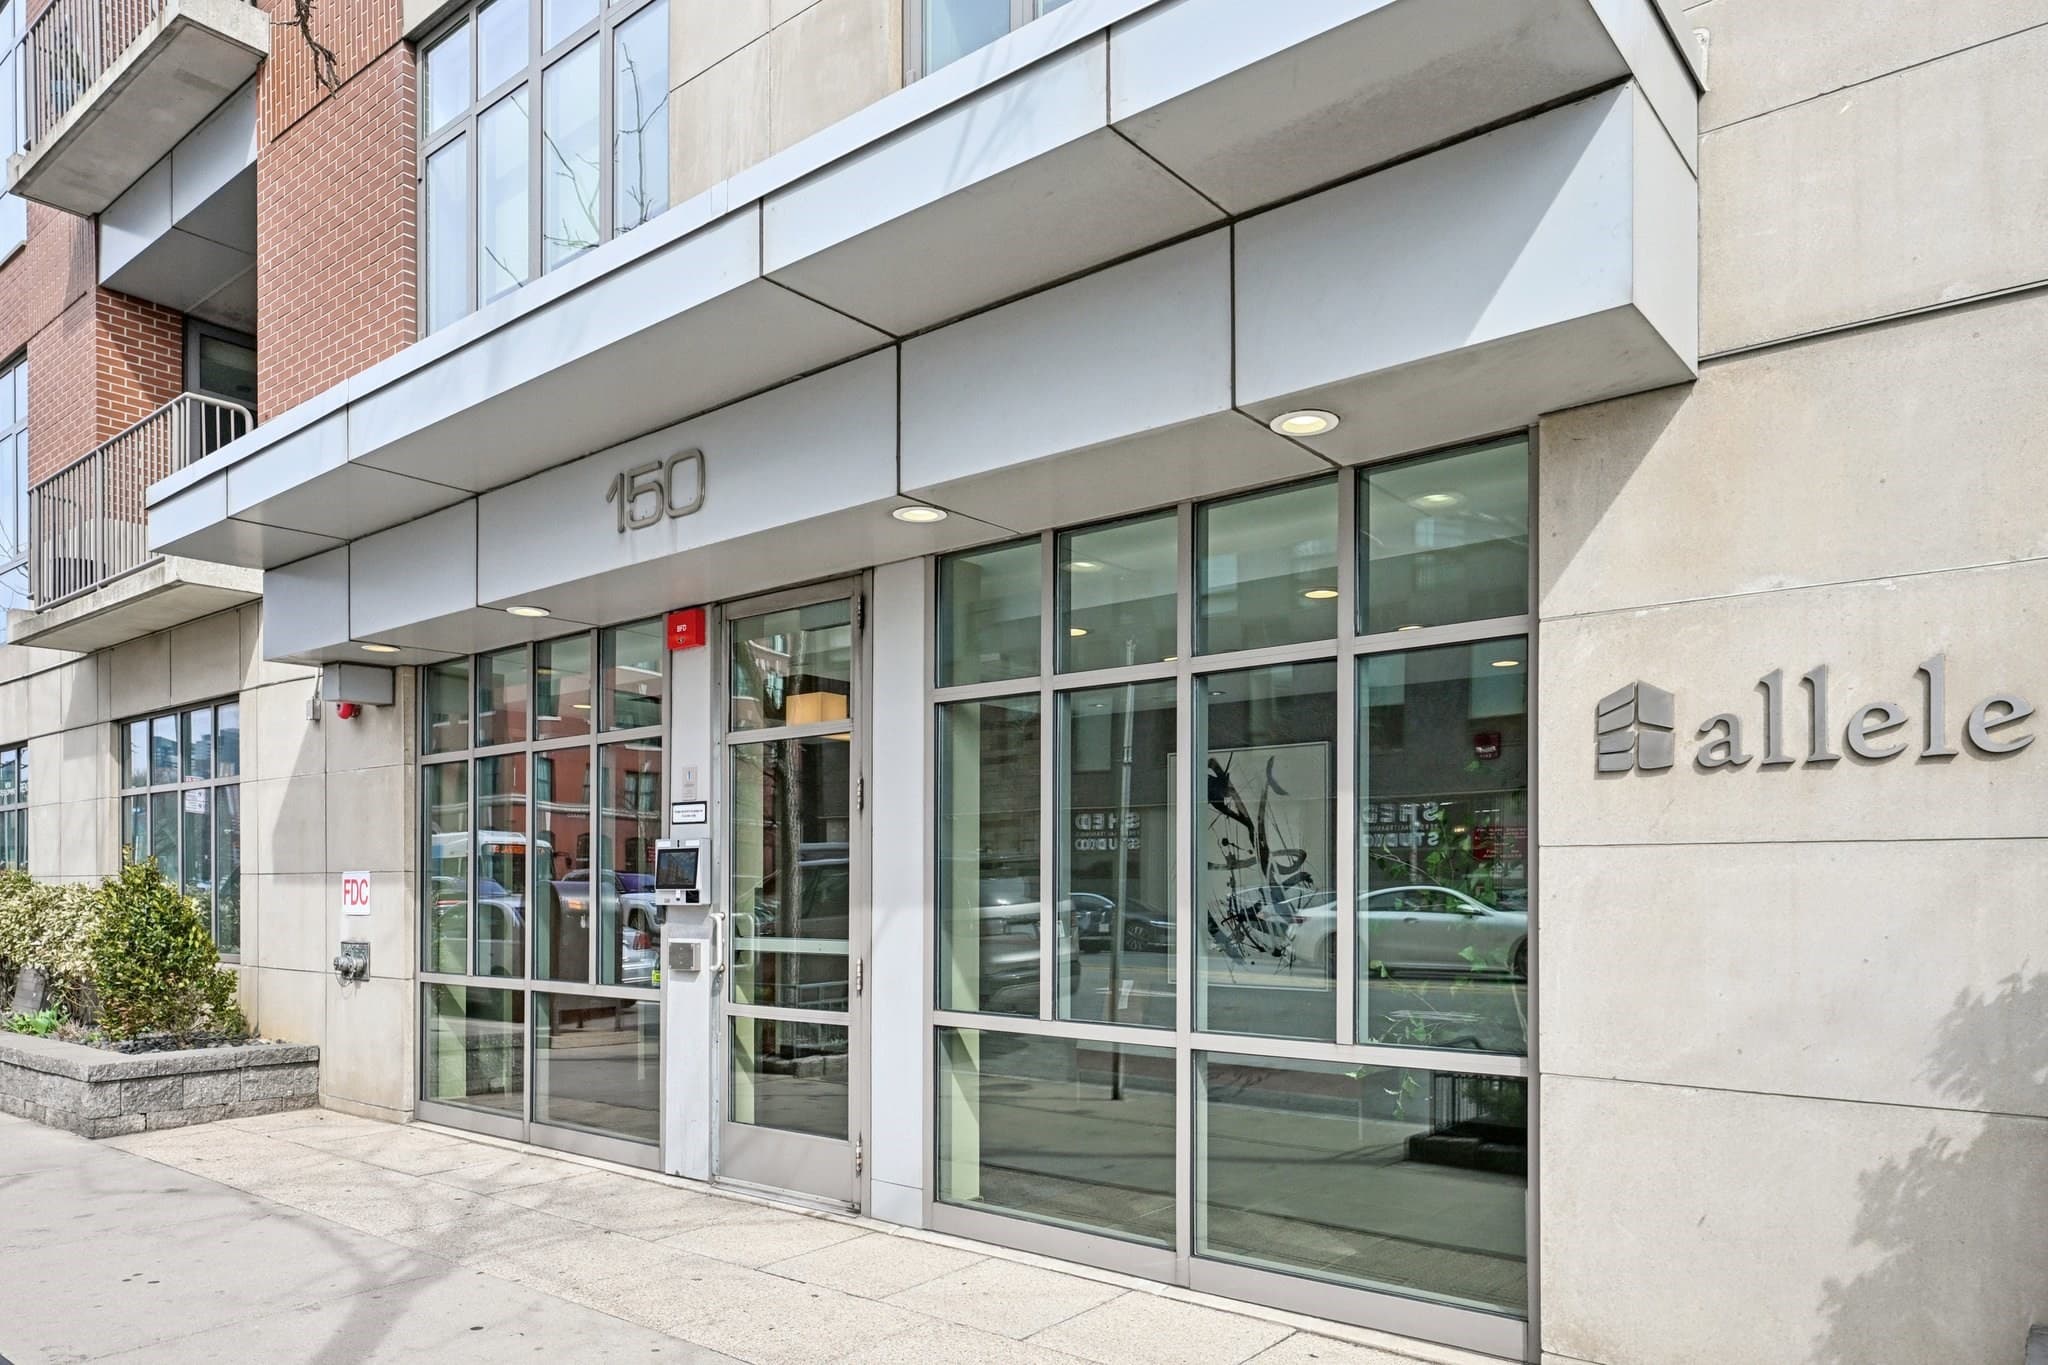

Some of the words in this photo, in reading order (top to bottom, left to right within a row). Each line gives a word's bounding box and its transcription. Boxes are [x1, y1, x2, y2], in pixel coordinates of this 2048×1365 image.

[606, 448, 706, 533] 150
[1696, 652, 2037, 768] allele
[343, 879, 369, 905] FDC
